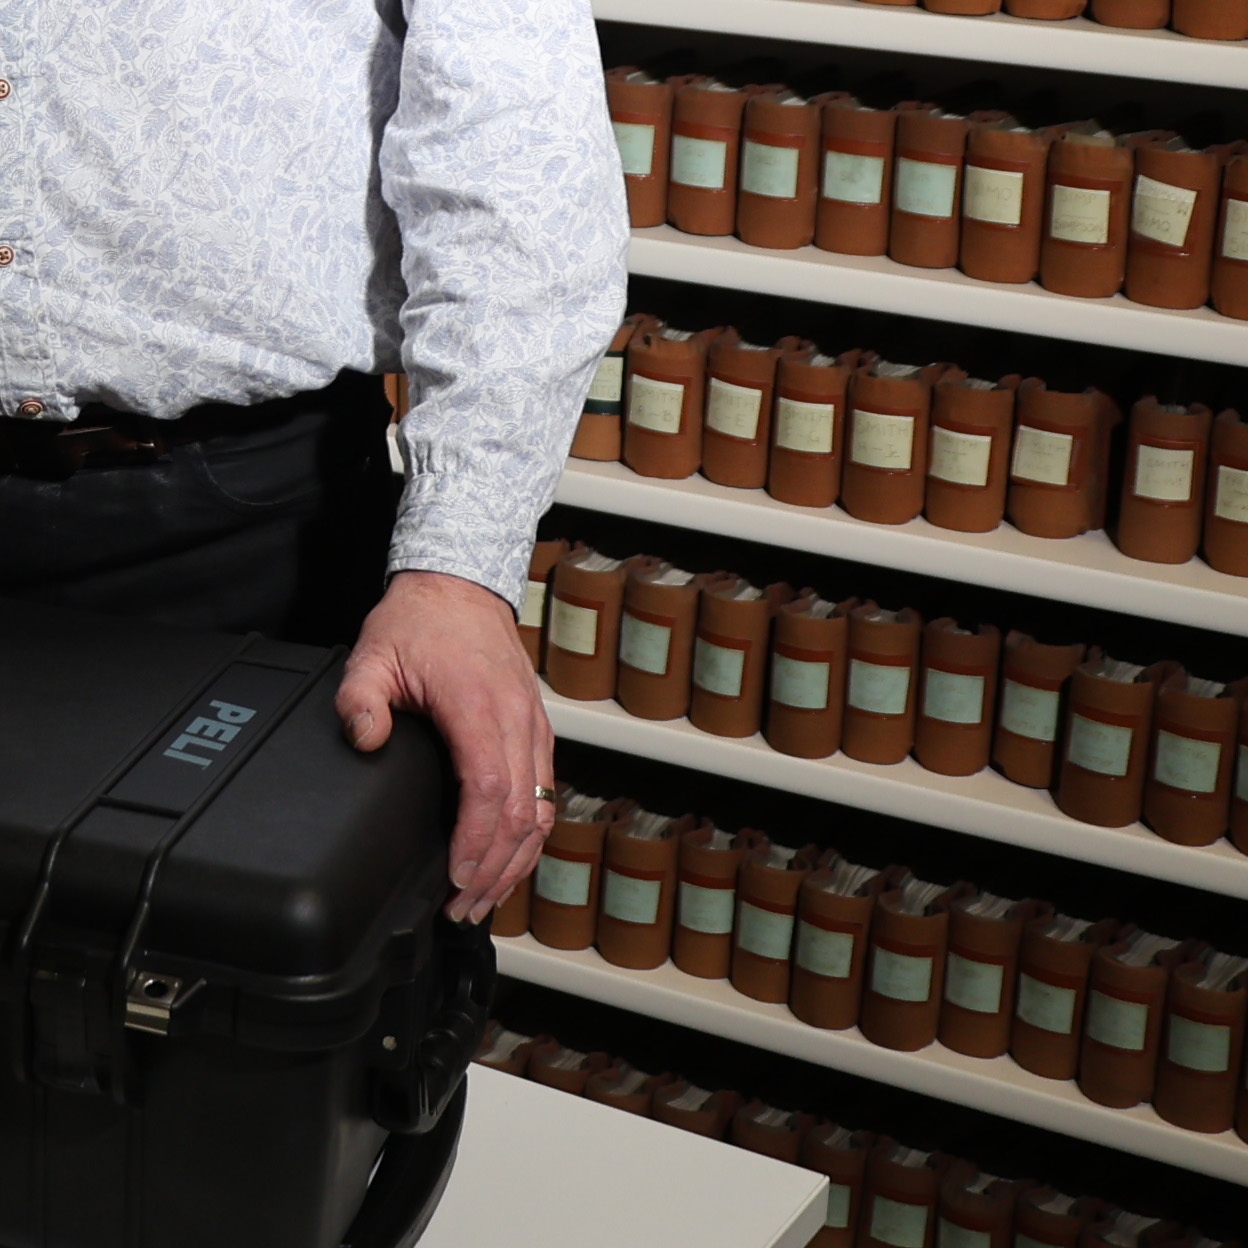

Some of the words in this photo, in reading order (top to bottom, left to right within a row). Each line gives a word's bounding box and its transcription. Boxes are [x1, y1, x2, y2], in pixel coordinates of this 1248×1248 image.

[783, 405, 828, 423] SMITH
[857, 418, 908, 438] SMITH
[163, 699, 257, 771] PELI
